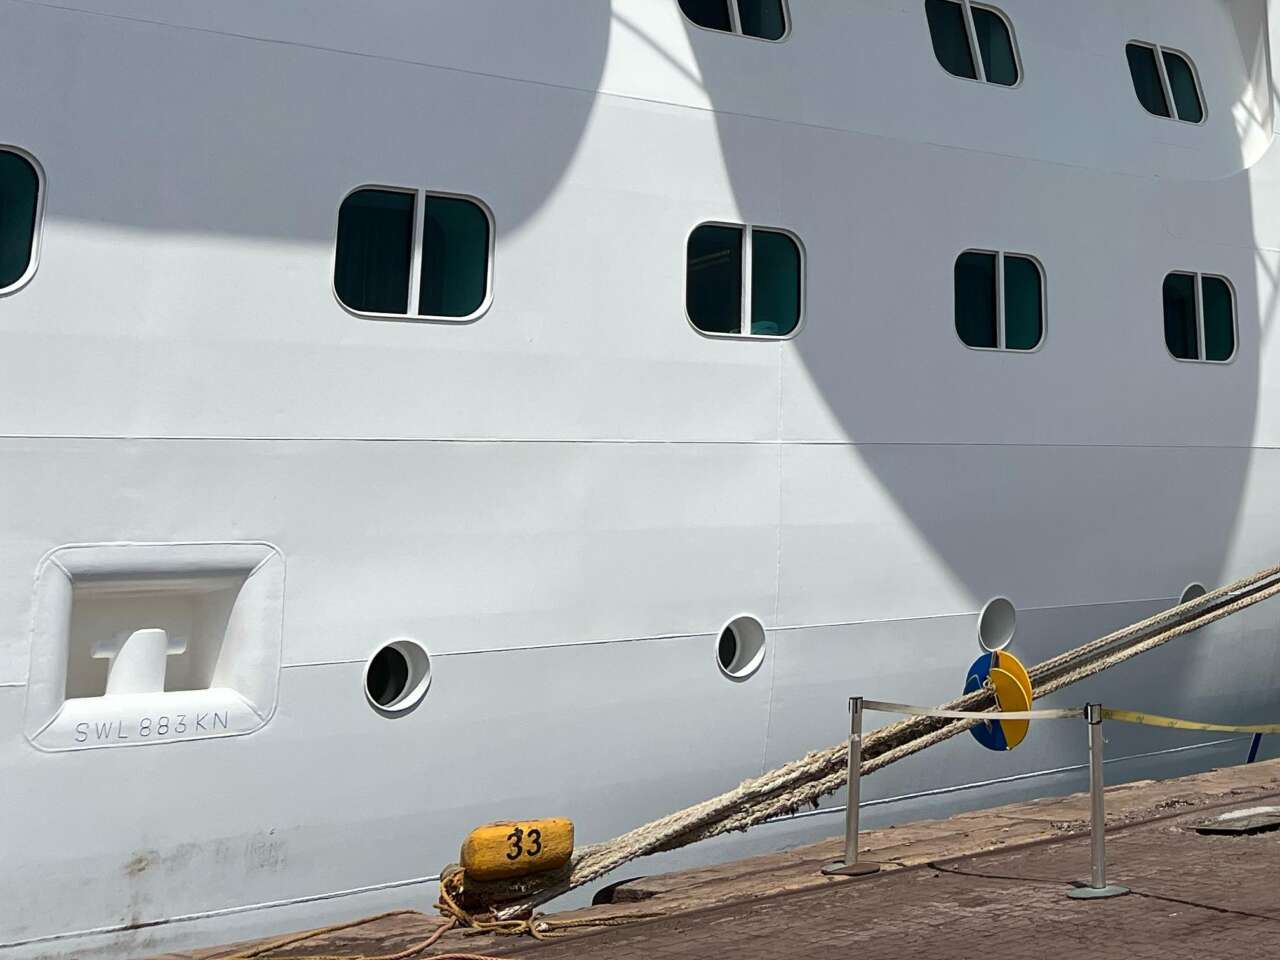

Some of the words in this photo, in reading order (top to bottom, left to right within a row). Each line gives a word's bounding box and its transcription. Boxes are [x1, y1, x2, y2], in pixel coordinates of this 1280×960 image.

[74, 720, 129, 743] SWL
[138, 714, 187, 737] 883
[194, 711, 229, 732] KN
[506, 826, 543, 861] 33
